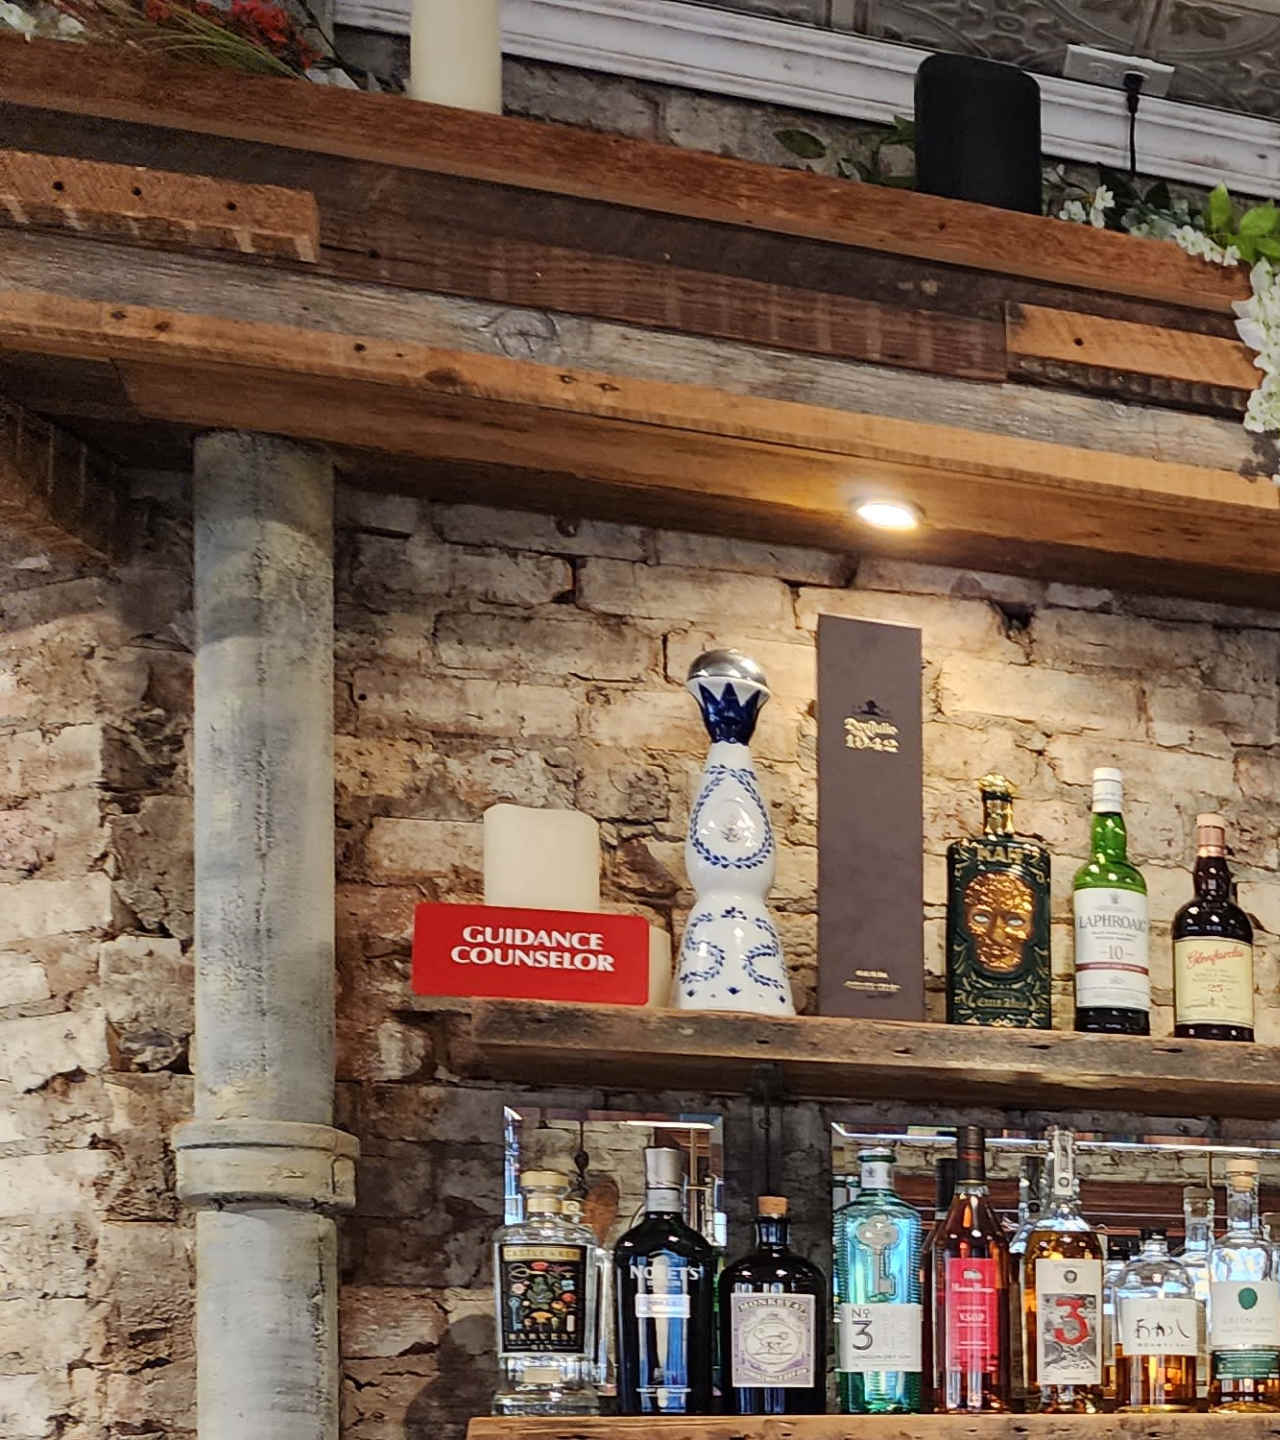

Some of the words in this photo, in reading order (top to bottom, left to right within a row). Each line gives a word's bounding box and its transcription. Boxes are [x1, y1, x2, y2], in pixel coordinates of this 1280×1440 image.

[462, 925, 604, 950] GUIDANCE
[450, 946, 614, 971] COUNSELOR
[1107, 944, 1123, 960] 10
[1053, 1299, 1088, 1345] 3
[852, 1320, 873, 1351] 3
